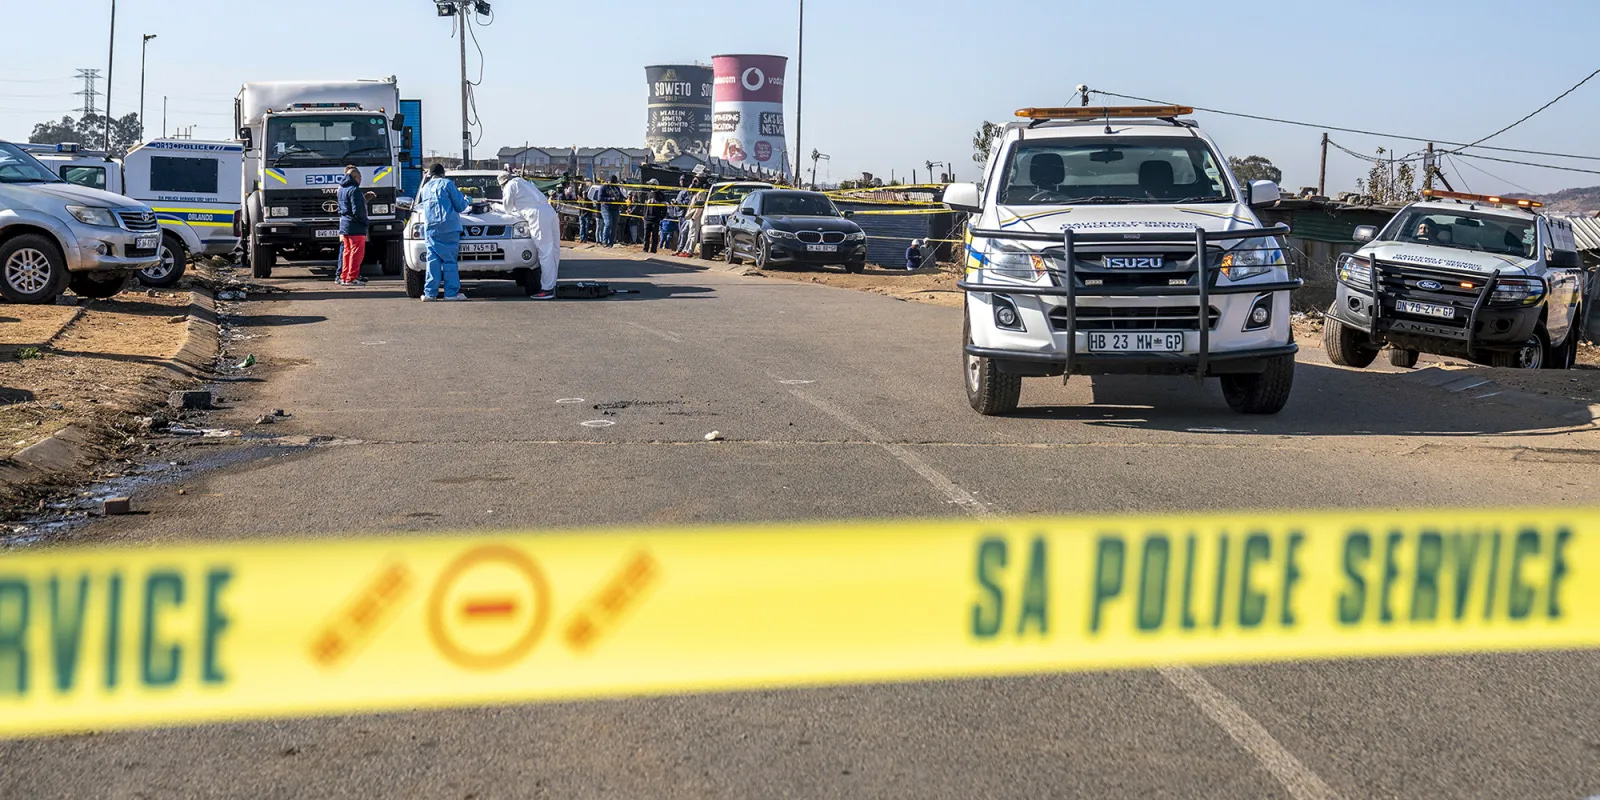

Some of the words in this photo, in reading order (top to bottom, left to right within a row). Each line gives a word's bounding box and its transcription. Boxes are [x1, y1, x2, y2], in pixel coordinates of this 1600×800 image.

[655, 82, 691, 97] SOWETO
[178, 143, 208, 151] POLICE
[187, 213, 213, 221] ORLANDO
[1107, 258, 1162, 268] ISUZU
[1421, 281, 1437, 290] Ford
[1397, 300, 1407, 310] DN
[1425, 304, 1435, 315] ZY
[1443, 306, 1454, 317] GP
[1395, 322, 1464, 337] ANGER
[1090, 334, 1106, 349] HB
[1113, 334, 1128, 349] 23
[1137, 334, 1152, 349] MW
[1166, 334, 1181, 349] GP
[972, 535, 1047, 638] SA
[1090, 530, 1306, 632] POLICE
[1337, 525, 1572, 624] SERVICE
